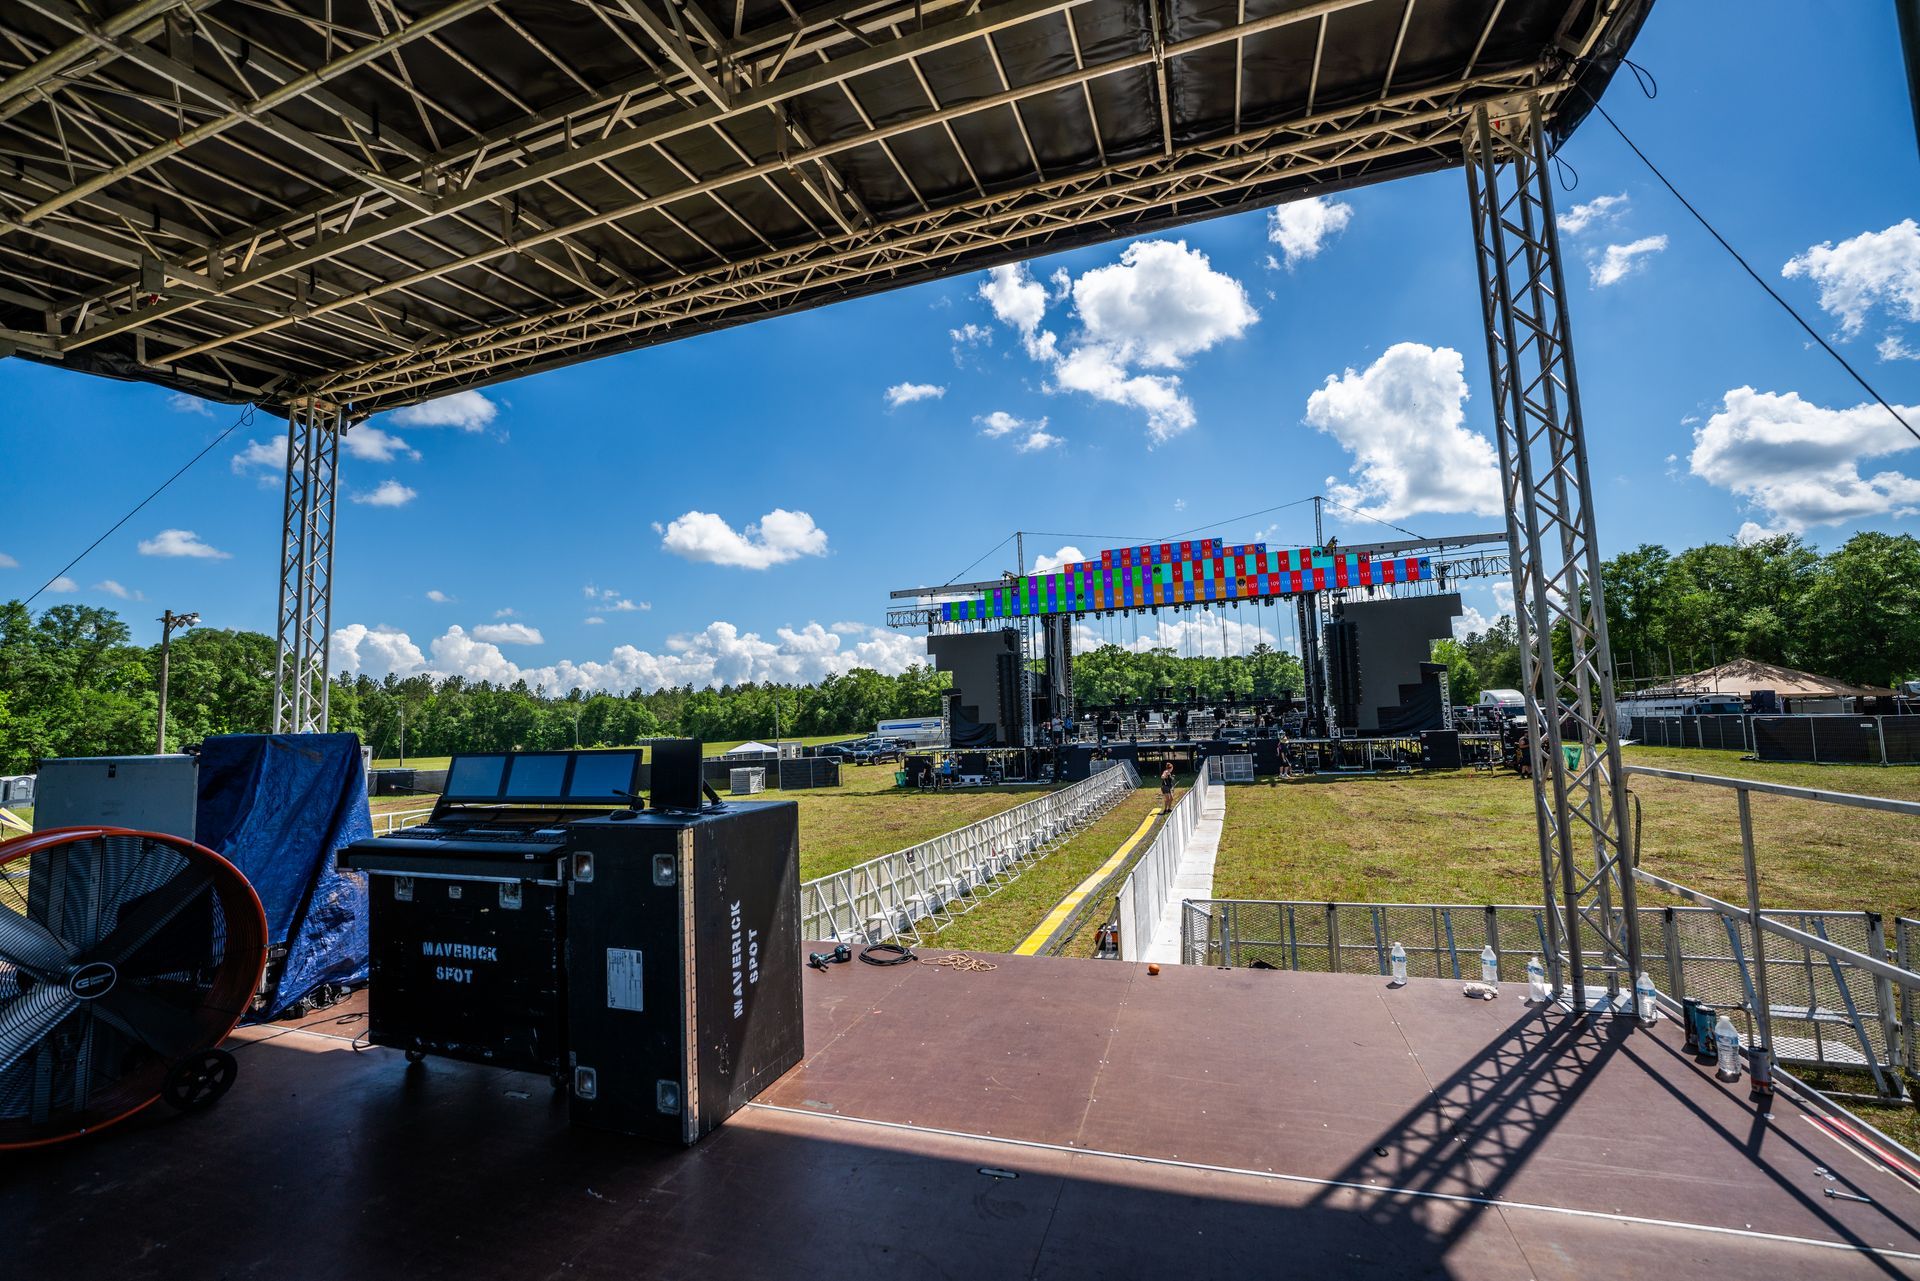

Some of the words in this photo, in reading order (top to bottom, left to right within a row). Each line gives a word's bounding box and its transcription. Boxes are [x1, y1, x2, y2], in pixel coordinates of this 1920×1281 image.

[423, 942, 498, 961] MAVERICK
[731, 900, 743, 1019] MAVERICK
[749, 929, 759, 984] SPOT
[436, 966, 473, 984] SPOT
